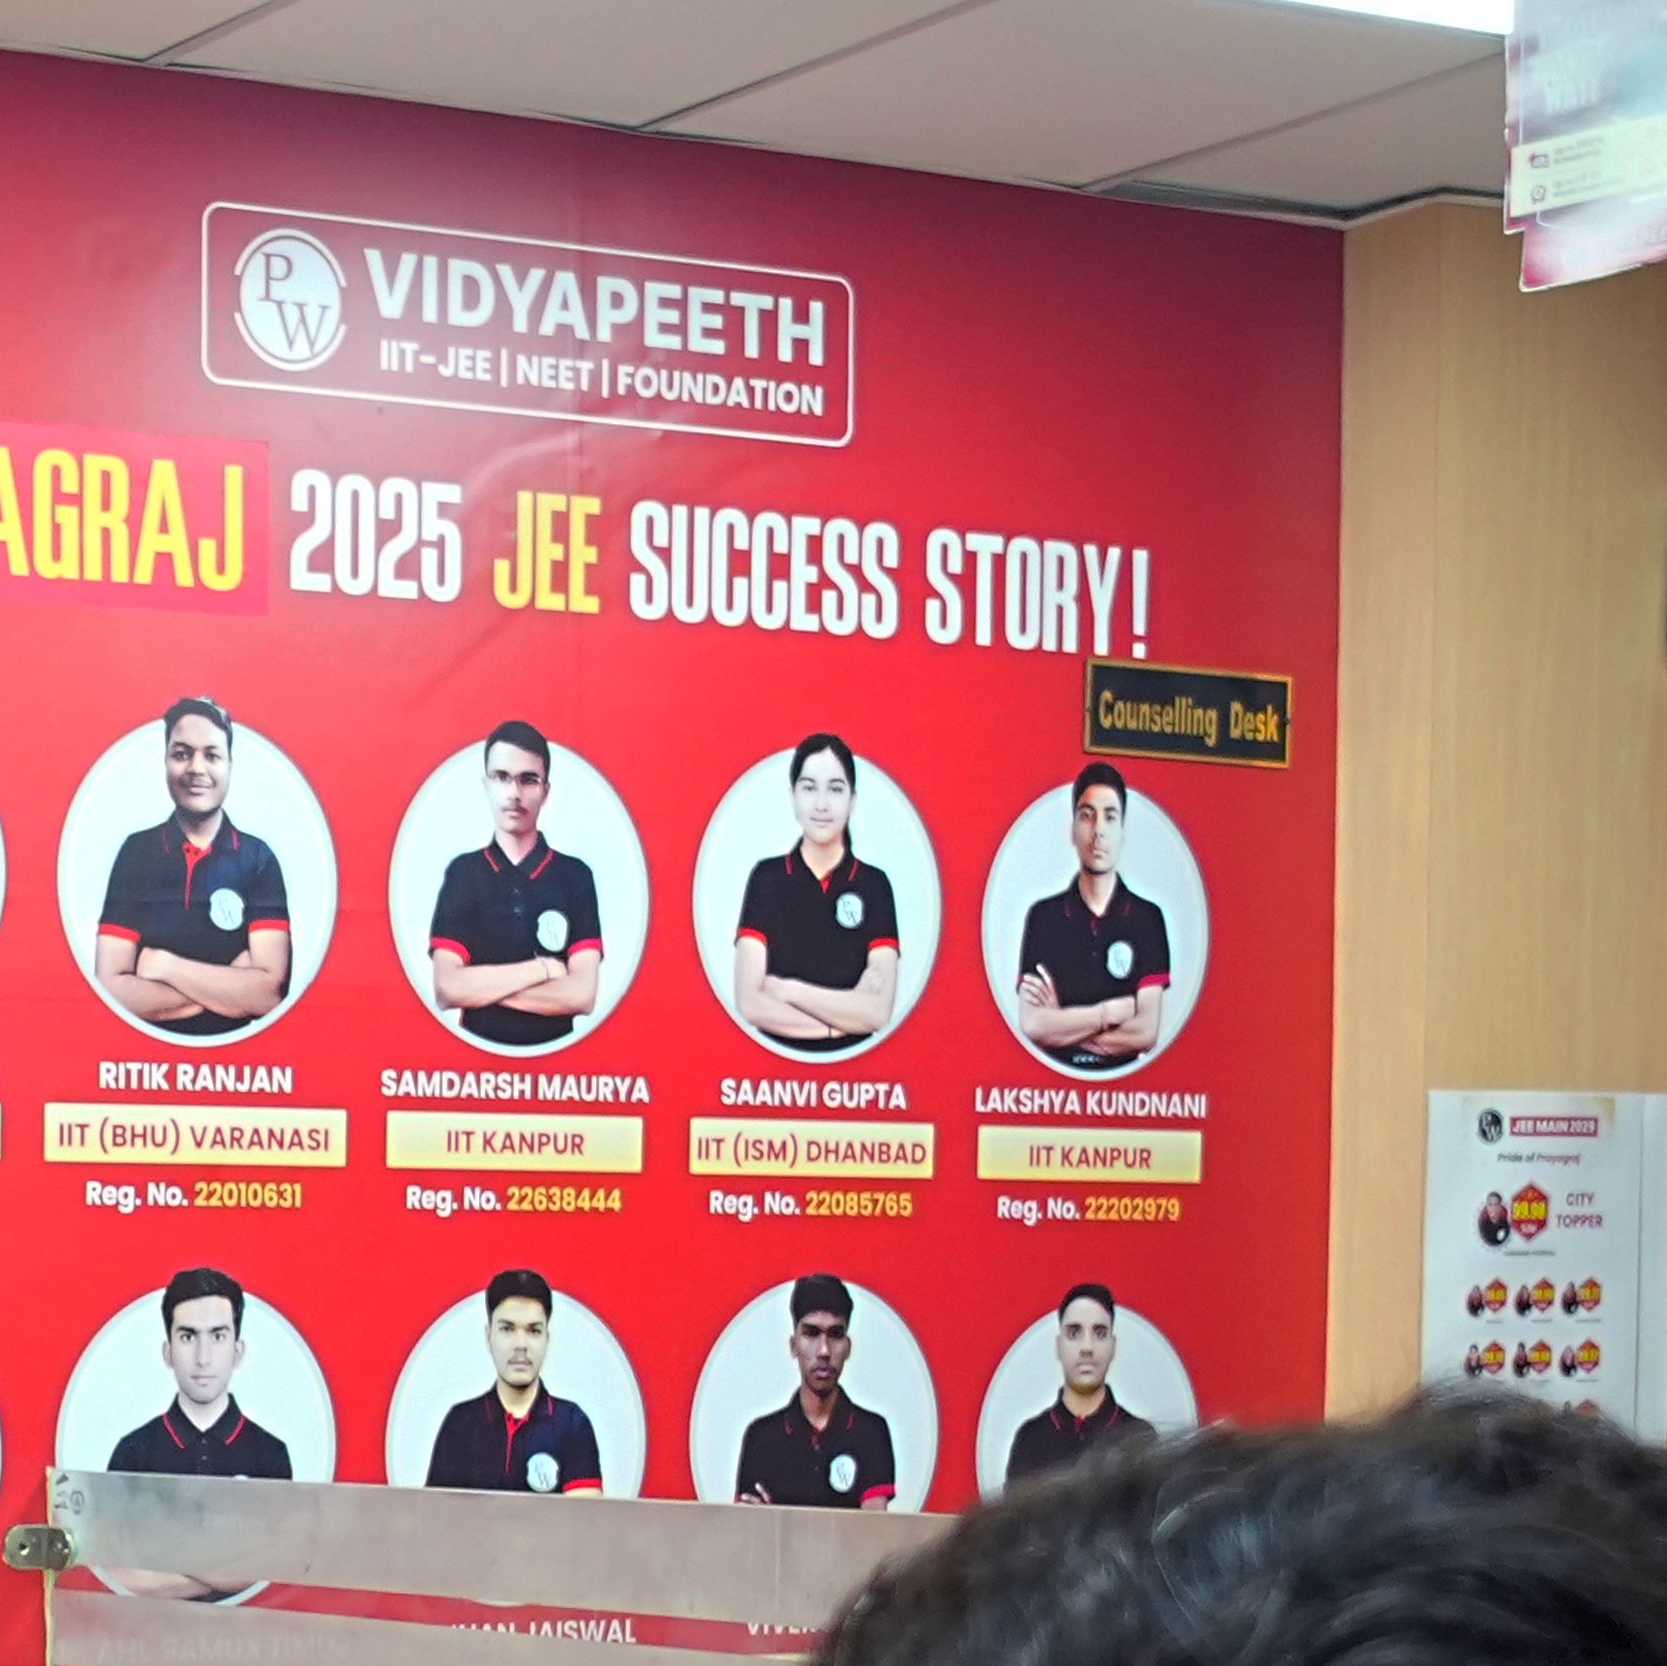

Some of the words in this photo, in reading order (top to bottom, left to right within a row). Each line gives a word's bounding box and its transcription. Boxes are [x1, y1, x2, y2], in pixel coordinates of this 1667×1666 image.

[364, 247, 825, 366] VIDYAPEETH
[380, 339, 492, 382] IIT-JEE
[517, 352, 593, 393] NEET
[618, 366, 824, 416] FOUNDATION
[289, 468, 462, 603] 2025
[493, 490, 600, 615] JEE
[629, 499, 899, 641] SUCCESS
[926, 527, 1150, 659] STORY!
[1098, 690, 1217, 747] Counselling
[1229, 700, 1280, 743] Desk
[99, 1061, 168, 1091] RITIK
[176, 1063, 292, 1093] RANJAN
[381, 1068, 533, 1101] SAMDARSH
[537, 1073, 650, 1104] MAURYA
[720, 1078, 819, 1108] SAANVI
[823, 1081, 907, 1110] GUPTA
[975, 1087, 1082, 1115] LAKSHYA
[1086, 1091, 1207, 1118] KUNDNANI
[59, 1122, 90, 1148] IIT
[99, 1120, 180, 1155] (BHU)
[193, 1125, 330, 1152] VARANASI
[446, 1130, 475, 1153] IIT
[482, 1131, 585, 1156] KANPUR
[697, 1137, 725, 1161] IIT
[733, 1134, 797, 1168] (ISM)
[807, 1140, 927, 1165] DHANBAD
[1028, 1146, 1053, 1166] IIT
[1060, 1146, 1151, 1169] KANPUR
[85, 1180, 141, 1212] Reg.
[147, 1181, 188, 1208] No.
[193, 1181, 302, 1209] 22010631
[406, 1186, 457, 1217] Reg.
[463, 1187, 501, 1211] No.
[507, 1187, 622, 1212] 22638444
[709, 1192, 758, 1222] Reg.
[764, 1192, 801, 1215] No.
[805, 1192, 912, 1217] 22085765
[997, 1197, 1042, 1225] Reg.
[1048, 1198, 1080, 1220] No.
[1084, 1197, 1180, 1221] 22202979
